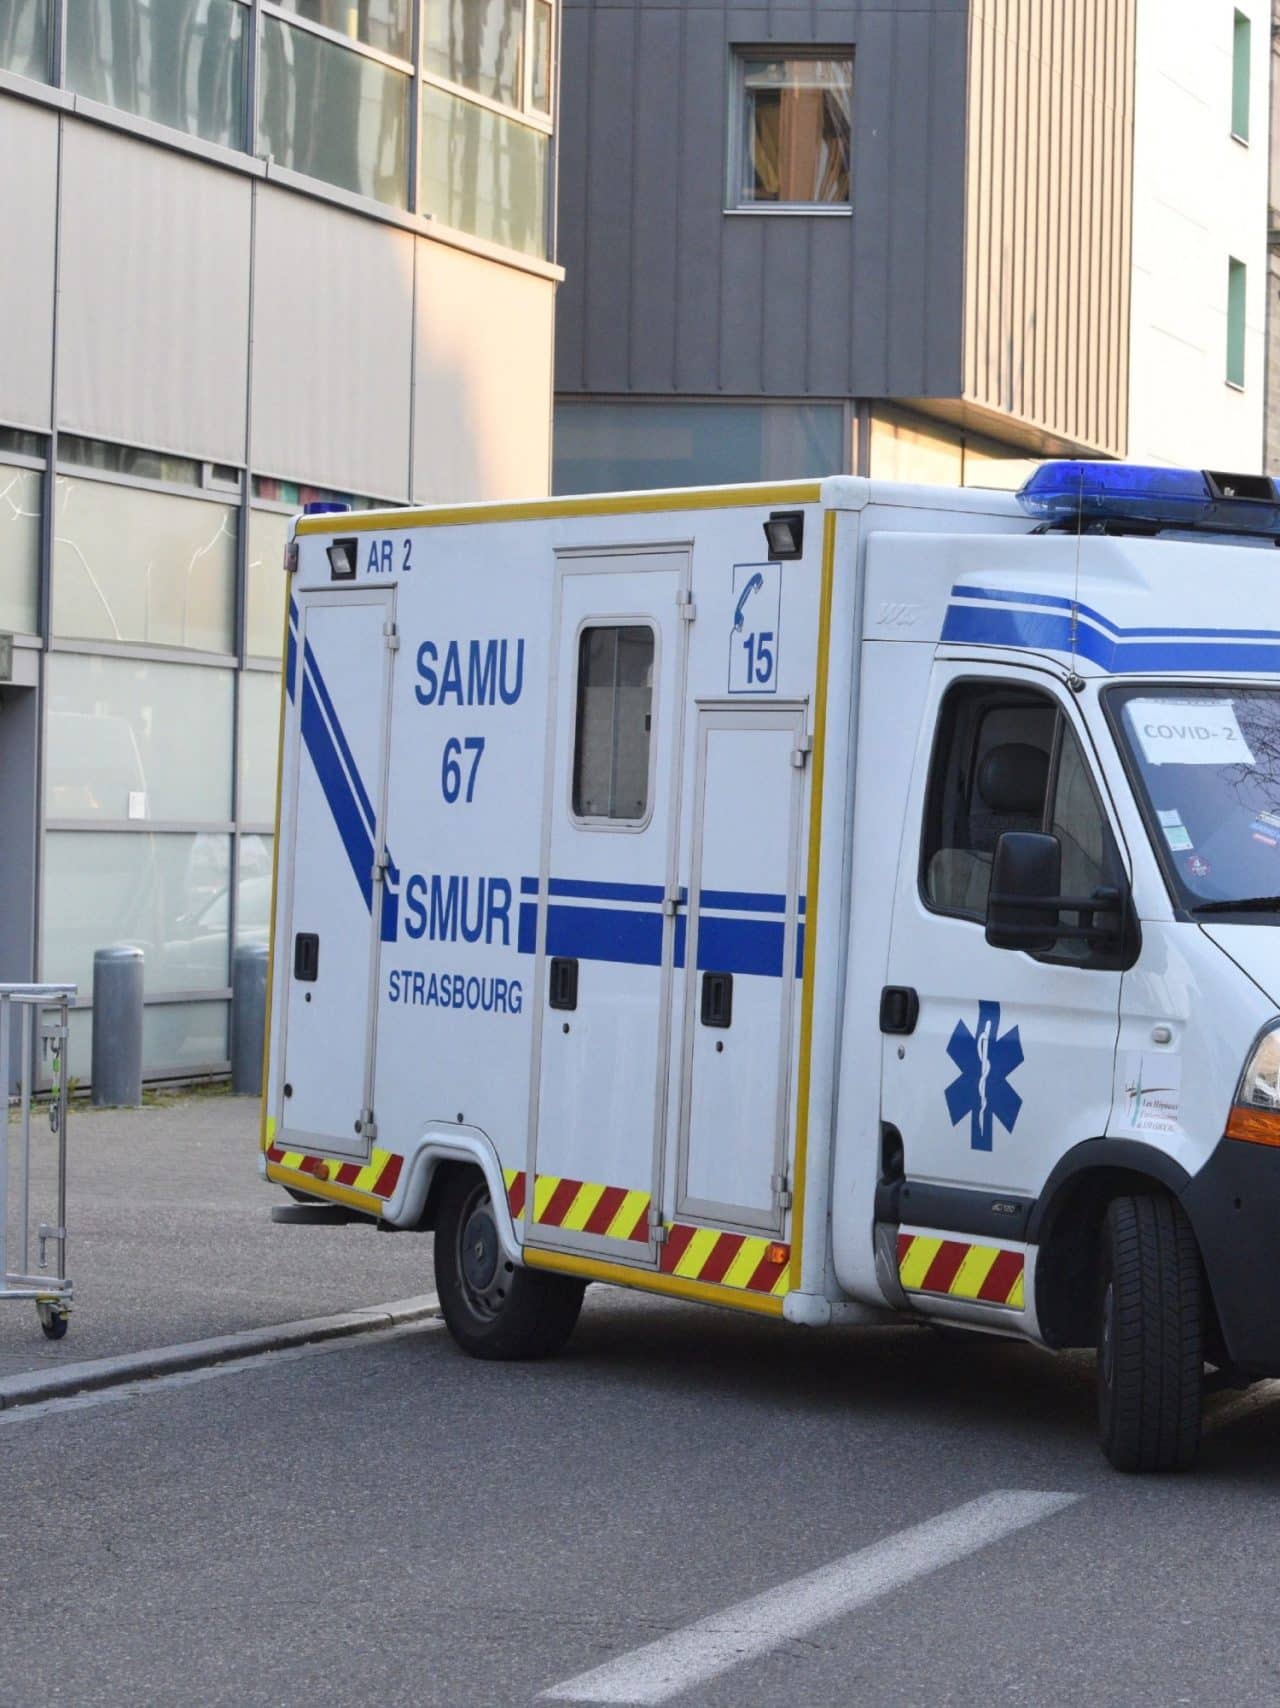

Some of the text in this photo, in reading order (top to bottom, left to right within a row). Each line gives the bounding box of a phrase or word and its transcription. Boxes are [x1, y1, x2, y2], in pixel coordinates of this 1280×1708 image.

[367, 538, 412, 573] AR 2
[414, 638, 525, 706] SAMU
[743, 631, 773, 684] 15
[441, 736, 486, 804] 67
[404, 873, 513, 946] SMUR
[388, 970, 523, 1014] STRASBOURG
